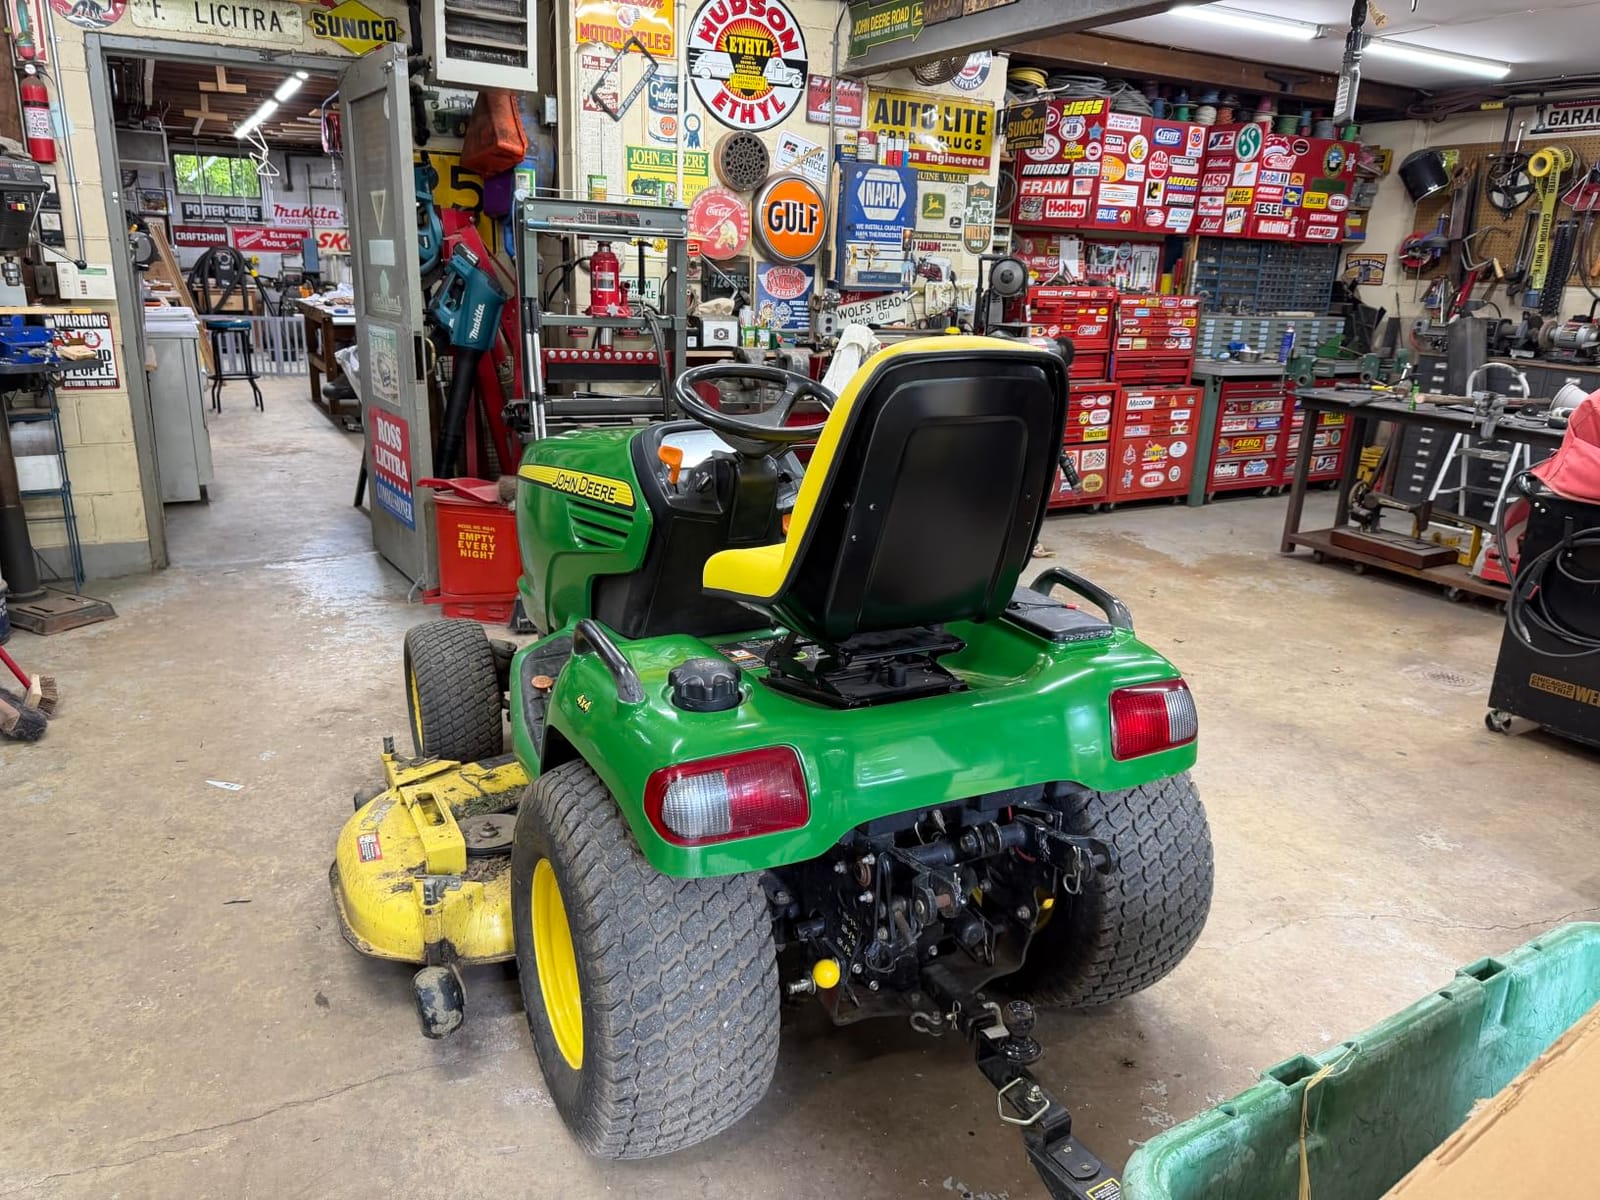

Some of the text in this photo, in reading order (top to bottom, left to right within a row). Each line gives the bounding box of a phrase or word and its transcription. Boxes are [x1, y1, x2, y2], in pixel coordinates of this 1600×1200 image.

[195, 1, 283, 33] LICITRA
[855, 20, 870, 35] JOHN
[871, 11, 890, 31] DEERE
[891, 7, 910, 25] ROAD
[313, 12, 397, 43] SUNOCO
[697, 0, 799, 53] HUDSON
[580, 23, 672, 51] MOTORCYCLES
[728, 36, 771, 57] ETHYL
[811, 77, 862, 91] STHL
[953, 76, 982, 90] ERVICE
[711, 89, 786, 124] ETHYL
[1063, 100, 1104, 115] JEGS
[661, 122, 676, 131] GULF
[1008, 117, 1045, 137] SUNOCO
[938, 136, 982, 151] PLUGS
[1191, 133, 1201, 143] 76
[631, 150, 706, 168] JOHN DERE
[926, 152, 984, 167] Engineered
[1022, 164, 1071, 176] MOROSO
[943, 174, 968, 184] VALUE
[1167, 176, 1198, 186] MOOG
[1203, 175, 1228, 186] MSD
[866, 182, 898, 207] NAPA
[1020, 180, 1069, 194] FRAM
[1048, 200, 1084, 216] Holley
[767, 200, 818, 234] GULF
[1226, 210, 1242, 222] WIX
[966, 226, 990, 241] WILLYS
[1540, 213, 1551, 243] CAUTION
[176, 232, 226, 242] CRAFTSMAN
[876, 297, 901, 310] HEAD
[54, 314, 108, 328] WARNING
[878, 311, 890, 321] Oil
[377, 417, 402, 452] ROSS
[1235, 439, 1260, 447] AERO
[376, 445, 408, 482] LICITRA
[552, 471, 617, 501] JOHN DEERE
[459, 532, 494, 543] EMPTY
[458, 540, 496, 551] EVERY
[460, 549, 494, 560] NIGHT
